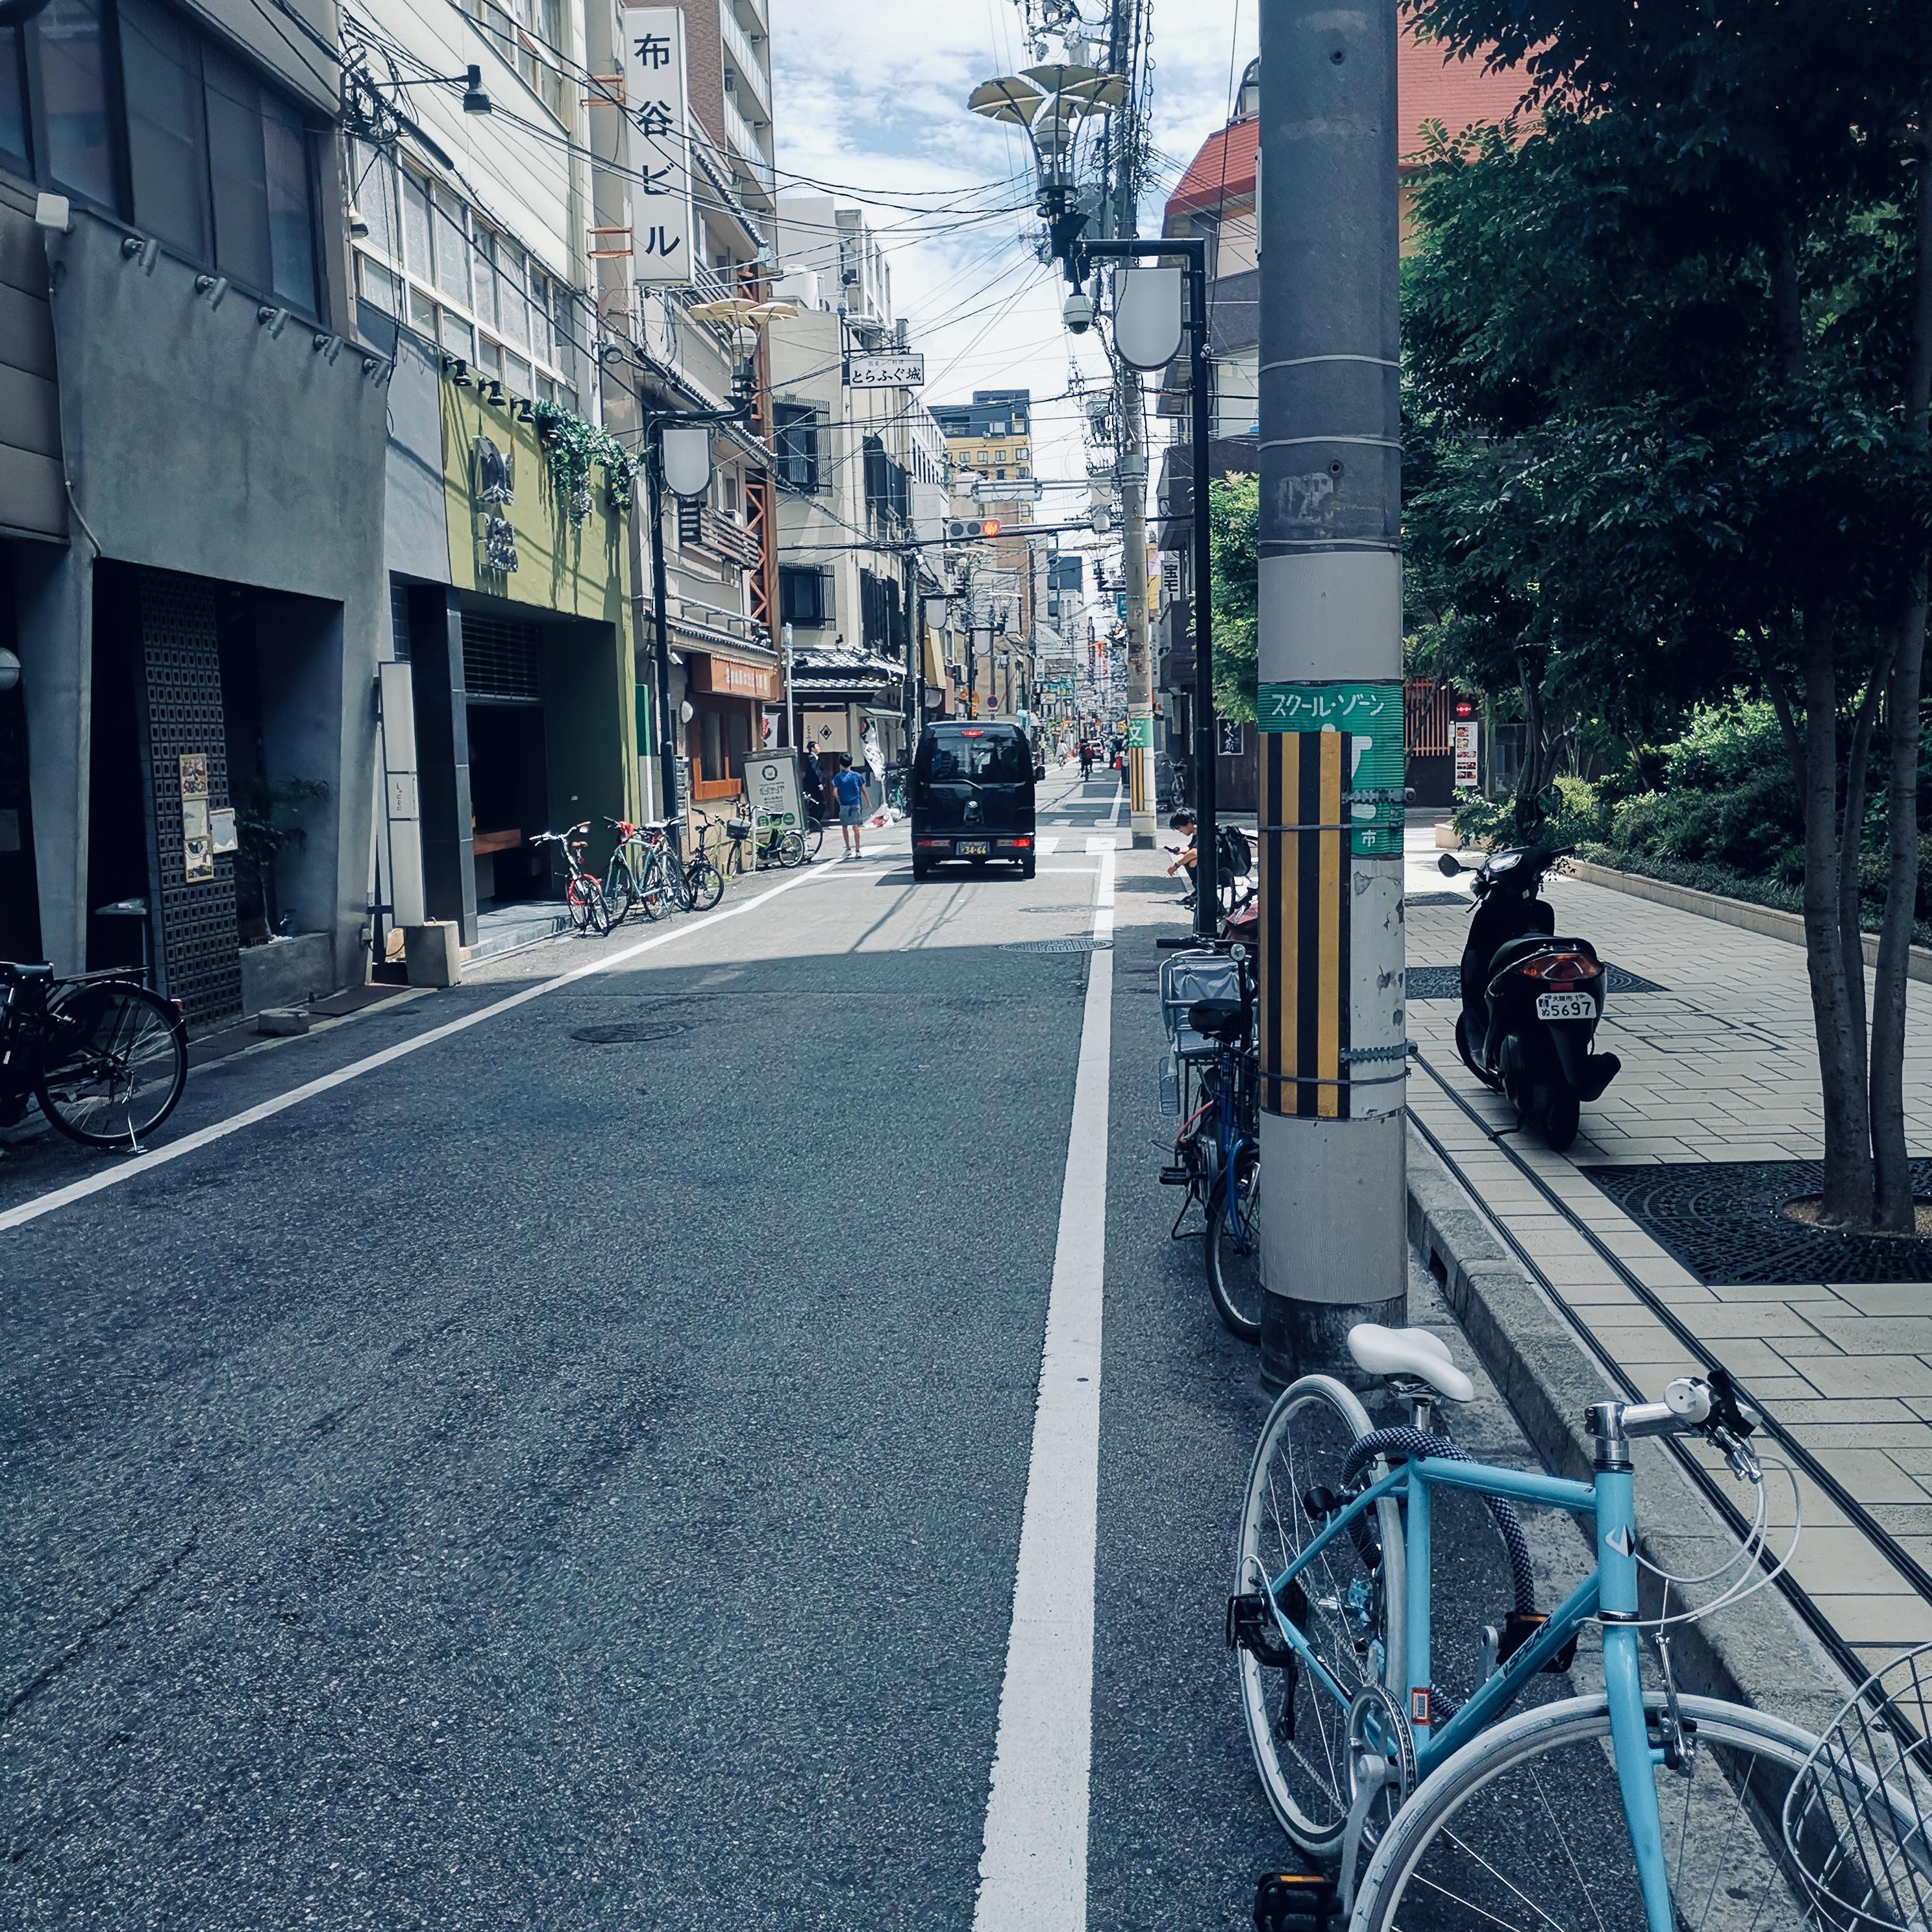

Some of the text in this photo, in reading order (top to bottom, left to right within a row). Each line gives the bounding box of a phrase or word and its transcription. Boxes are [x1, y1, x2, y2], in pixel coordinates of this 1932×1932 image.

[634, 33, 680, 257] 布谷ビル
[852, 367, 921, 384] とらふぐ城
[1129, 724, 1143, 741] 文
[1361, 829, 1377, 847] 市
[1550, 1001, 1591, 1017] 5697
